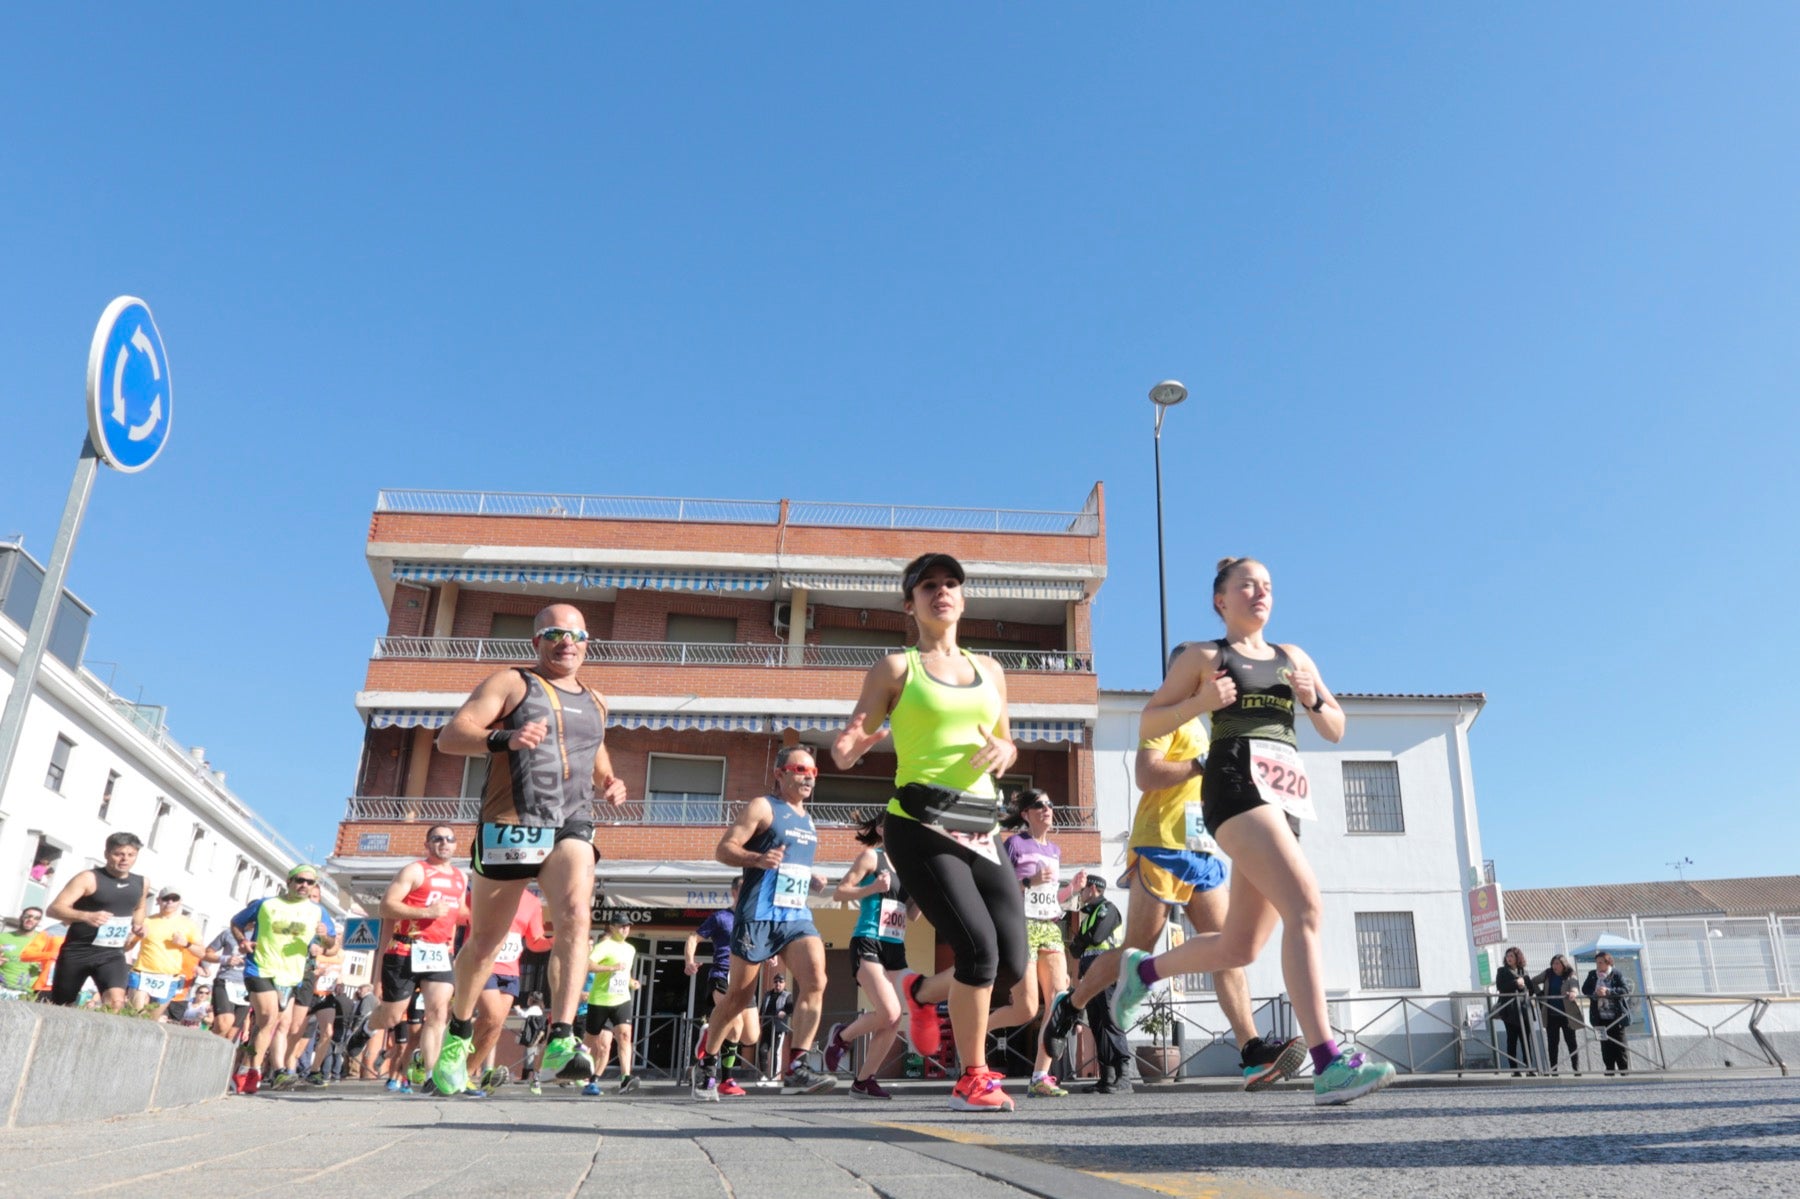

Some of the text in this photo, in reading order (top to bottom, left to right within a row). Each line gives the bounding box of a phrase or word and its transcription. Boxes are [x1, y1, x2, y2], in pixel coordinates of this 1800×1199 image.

[1257, 761, 1308, 799] 2220
[494, 822, 542, 844] 759
[106, 926, 128, 938] 325
[419, 949, 443, 961] 735
